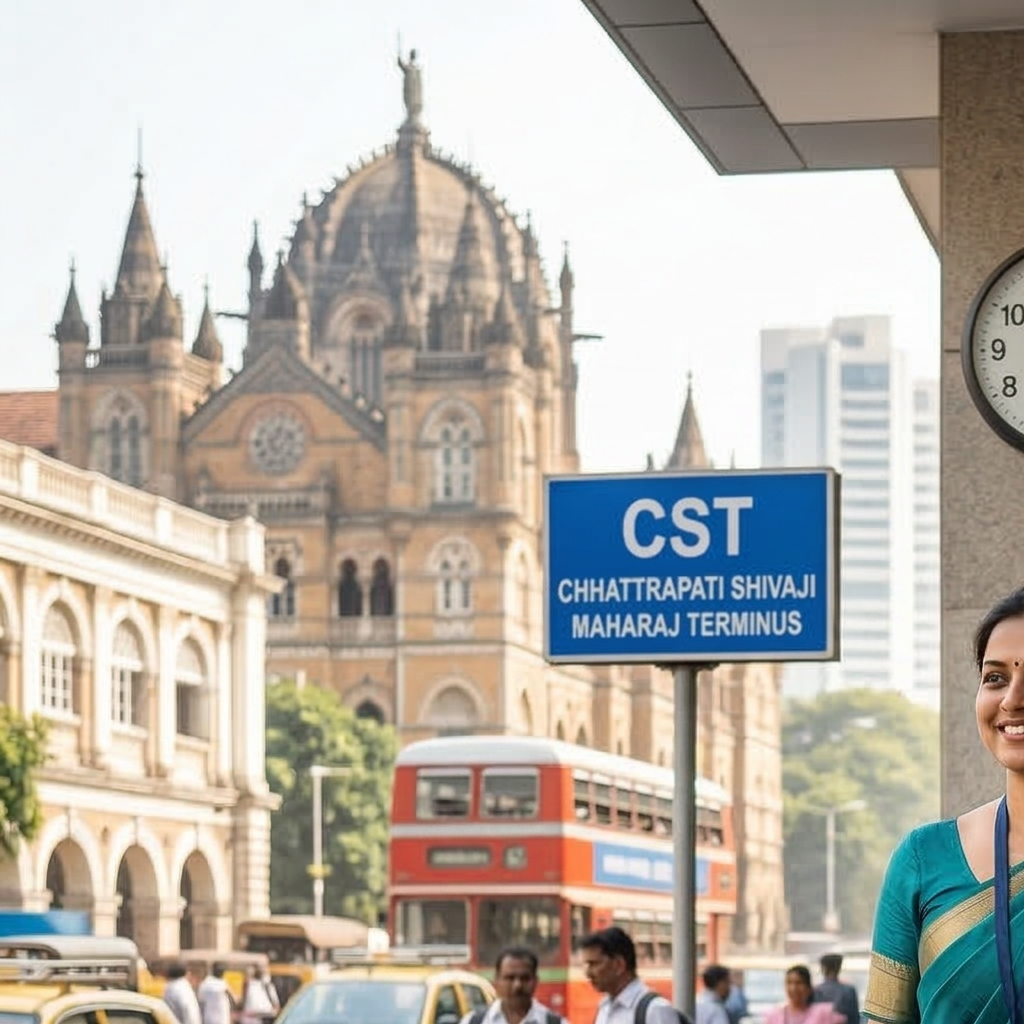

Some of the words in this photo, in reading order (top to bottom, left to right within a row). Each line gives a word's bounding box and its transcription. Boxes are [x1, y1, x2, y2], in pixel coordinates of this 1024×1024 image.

[991, 338, 1007, 362] 9
[1001, 375, 1018, 398] 8
[622, 496, 754, 559] CST
[557, 575, 724, 604] CHHATTRAPATI
[730, 573, 816, 600] SHIVAJI
[572, 612, 680, 639] MAHARAJ
[687, 610, 803, 637] TERMINUS
